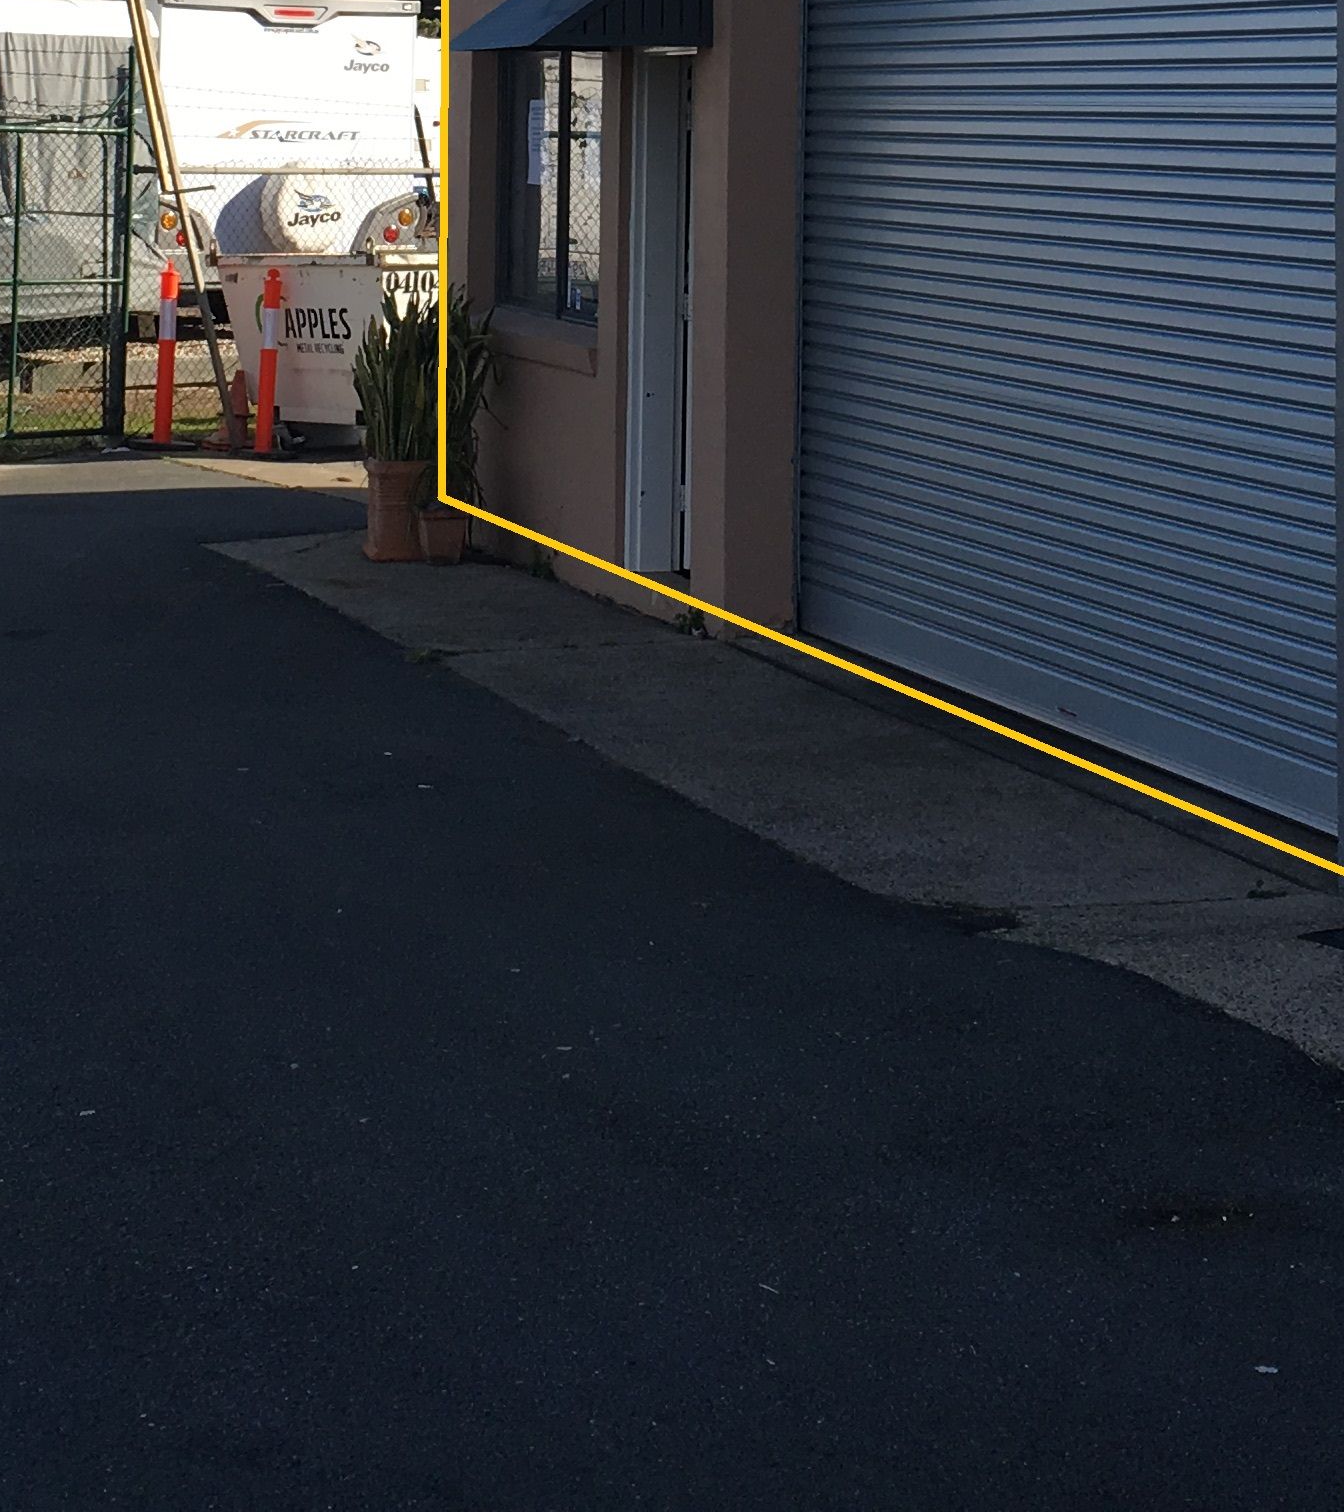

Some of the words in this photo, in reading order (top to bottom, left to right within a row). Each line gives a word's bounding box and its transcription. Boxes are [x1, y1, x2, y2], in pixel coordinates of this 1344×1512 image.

[344, 59, 390, 74] Jayco
[249, 129, 361, 142] STARCRAFT
[287, 211, 342, 228] Jayco
[386, 271, 438, 293] 0410
[285, 308, 352, 340] APPLES
